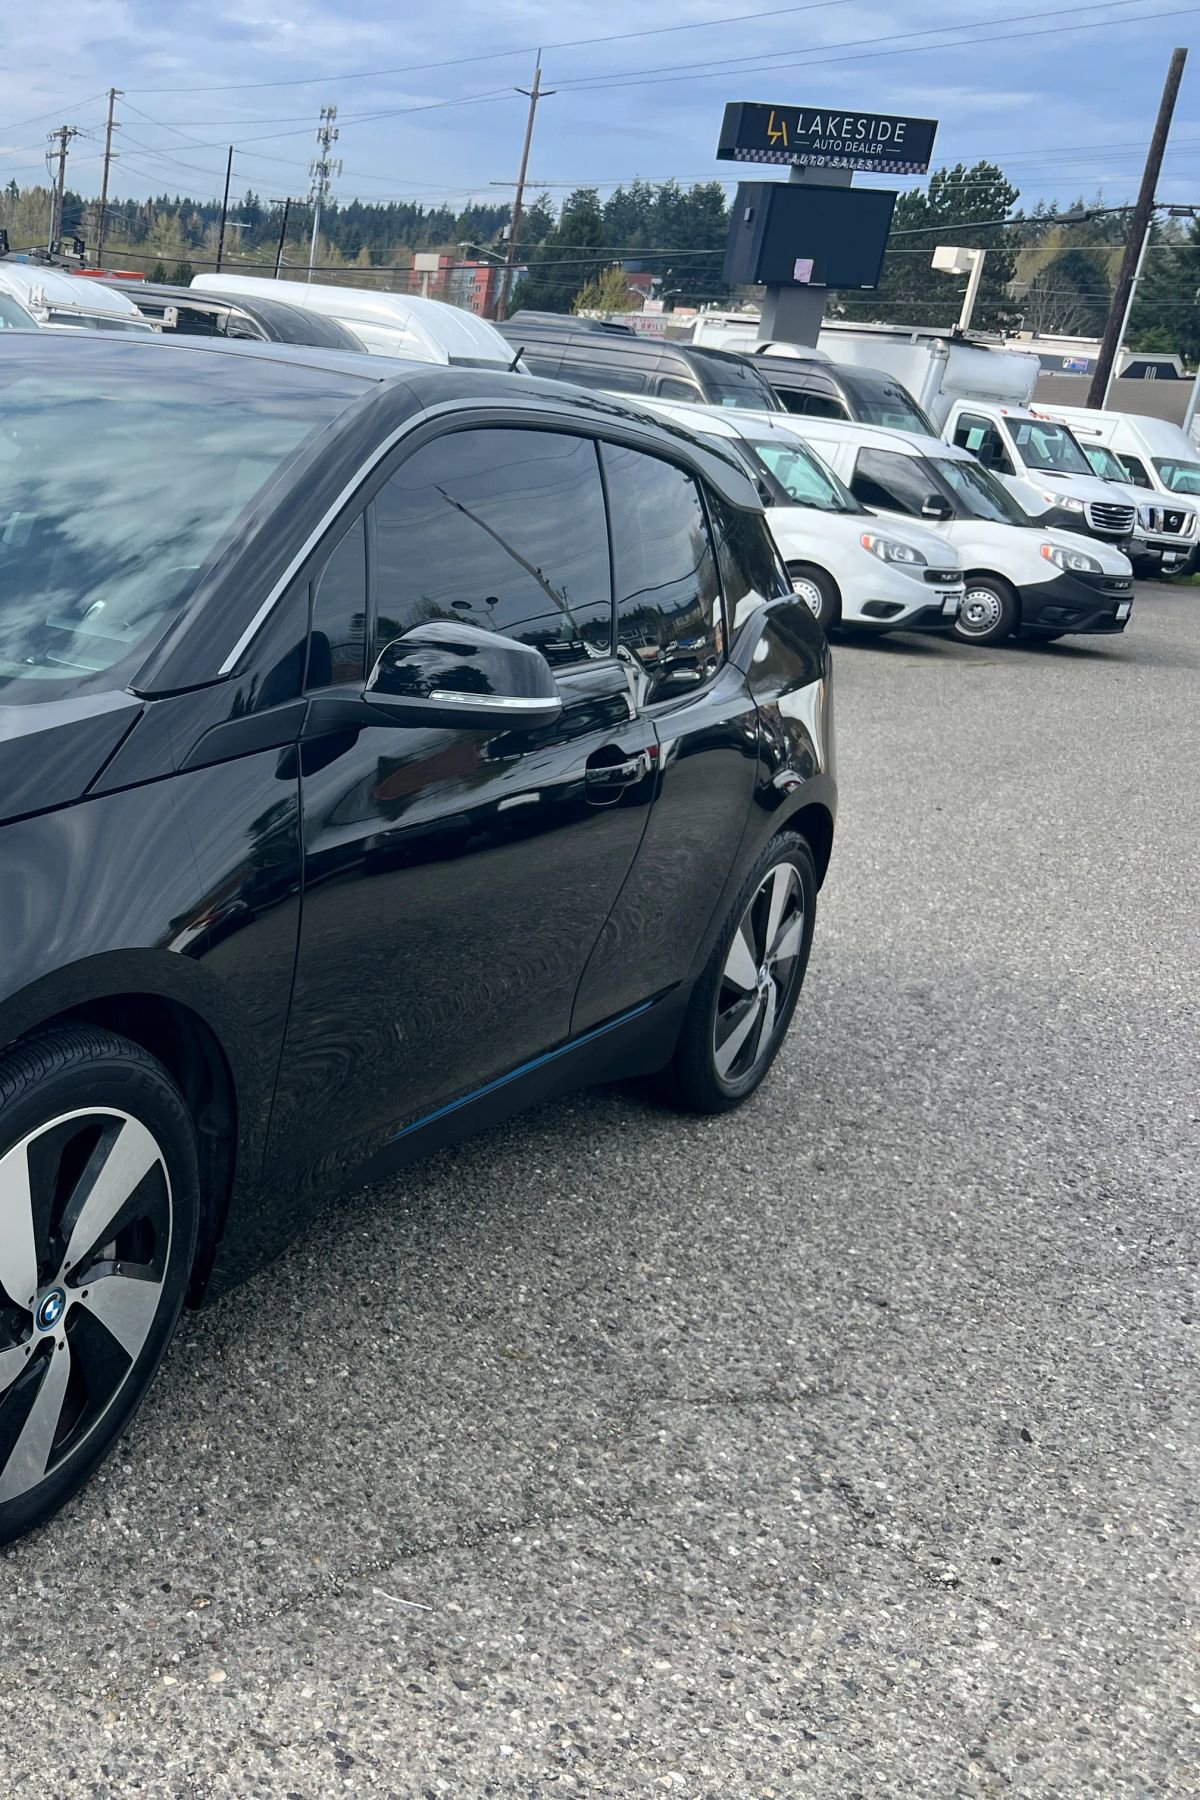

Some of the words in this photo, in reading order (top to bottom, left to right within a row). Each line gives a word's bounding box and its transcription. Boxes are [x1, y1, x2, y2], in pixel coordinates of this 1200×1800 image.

[796, 113, 907, 143] LAKESIDE
[812, 138, 843, 151] AUTO
[844, 141, 883, 155] DEALER
[790, 154, 825, 166] AUTO
[831, 156, 874, 170] SALES
